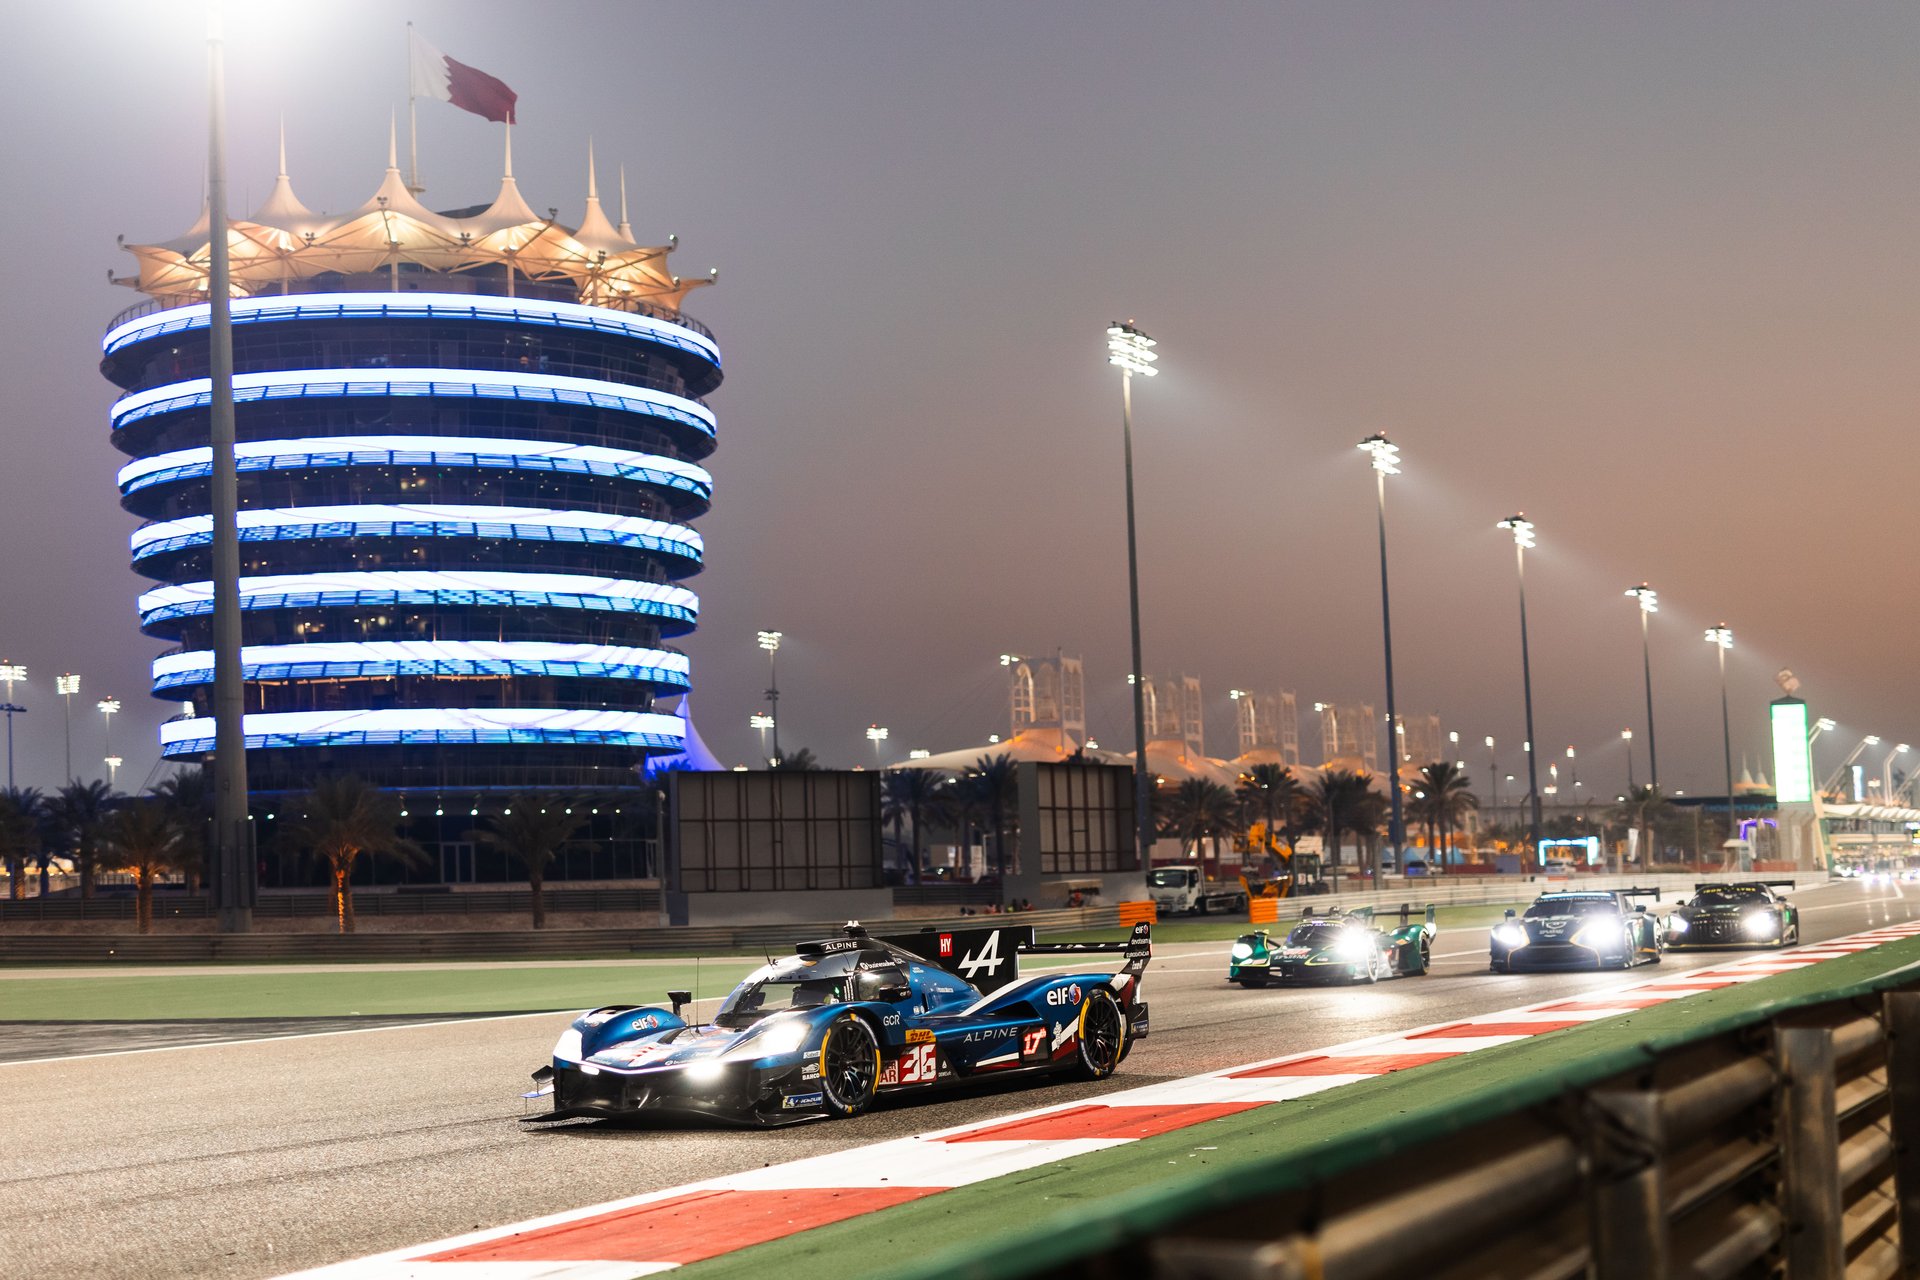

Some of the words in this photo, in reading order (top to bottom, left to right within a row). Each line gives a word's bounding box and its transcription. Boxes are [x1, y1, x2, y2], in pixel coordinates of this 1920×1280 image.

[825, 941, 858, 951] ALPINE
[940, 938, 951, 953] HY
[1046, 987, 1069, 1006] elf
[631, 1017, 648, 1031] elf
[883, 1014, 900, 1027] GCR
[910, 1030, 932, 1041] DHL
[963, 1026, 1018, 1043] ALPINE
[901, 1044, 936, 1083] 36
[880, 1069, 897, 1083] AR
